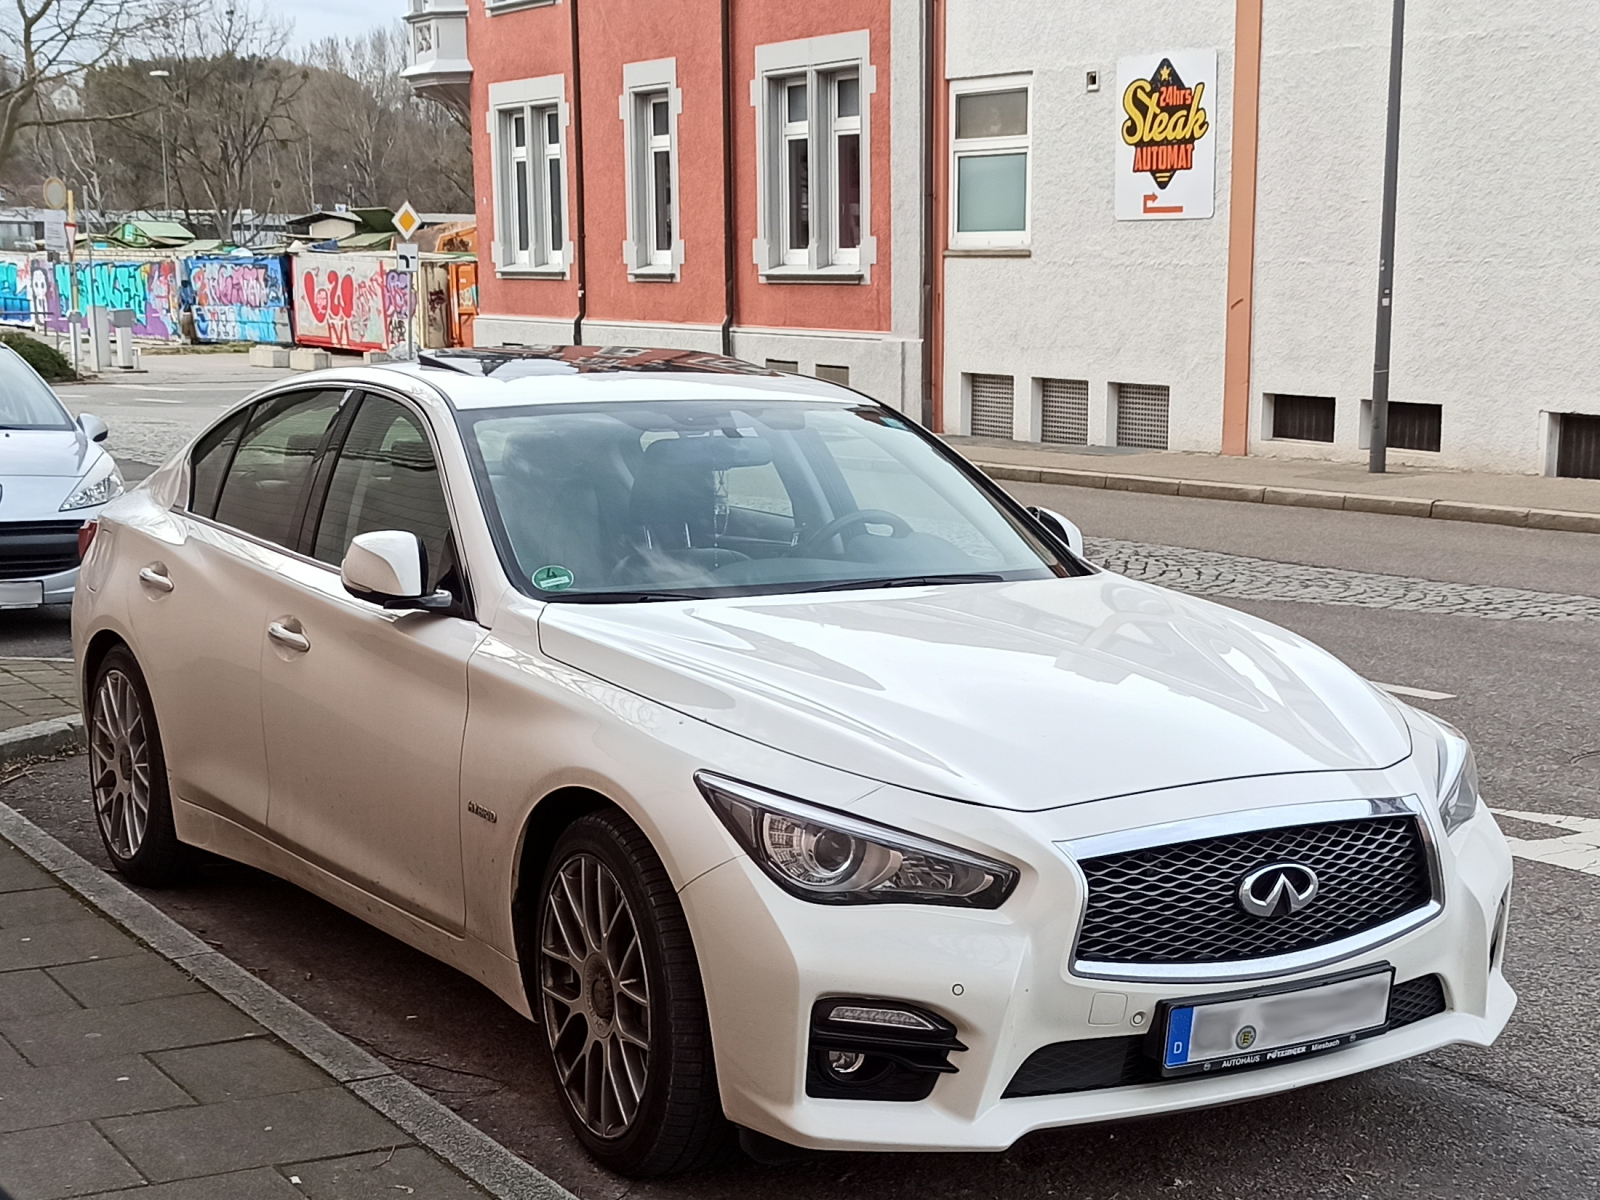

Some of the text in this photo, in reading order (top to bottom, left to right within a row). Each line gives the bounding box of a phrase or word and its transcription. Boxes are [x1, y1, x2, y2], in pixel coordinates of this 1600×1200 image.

[1160, 85, 1192, 107] 24hrs
[1123, 79, 1209, 145] Steak
[1134, 144, 1194, 171] AUTOMAT
[1173, 1041, 1183, 1054] D
[1221, 1055, 1260, 1068] AUTOHAUS
[1311, 1039, 1340, 1051] Miesbach
